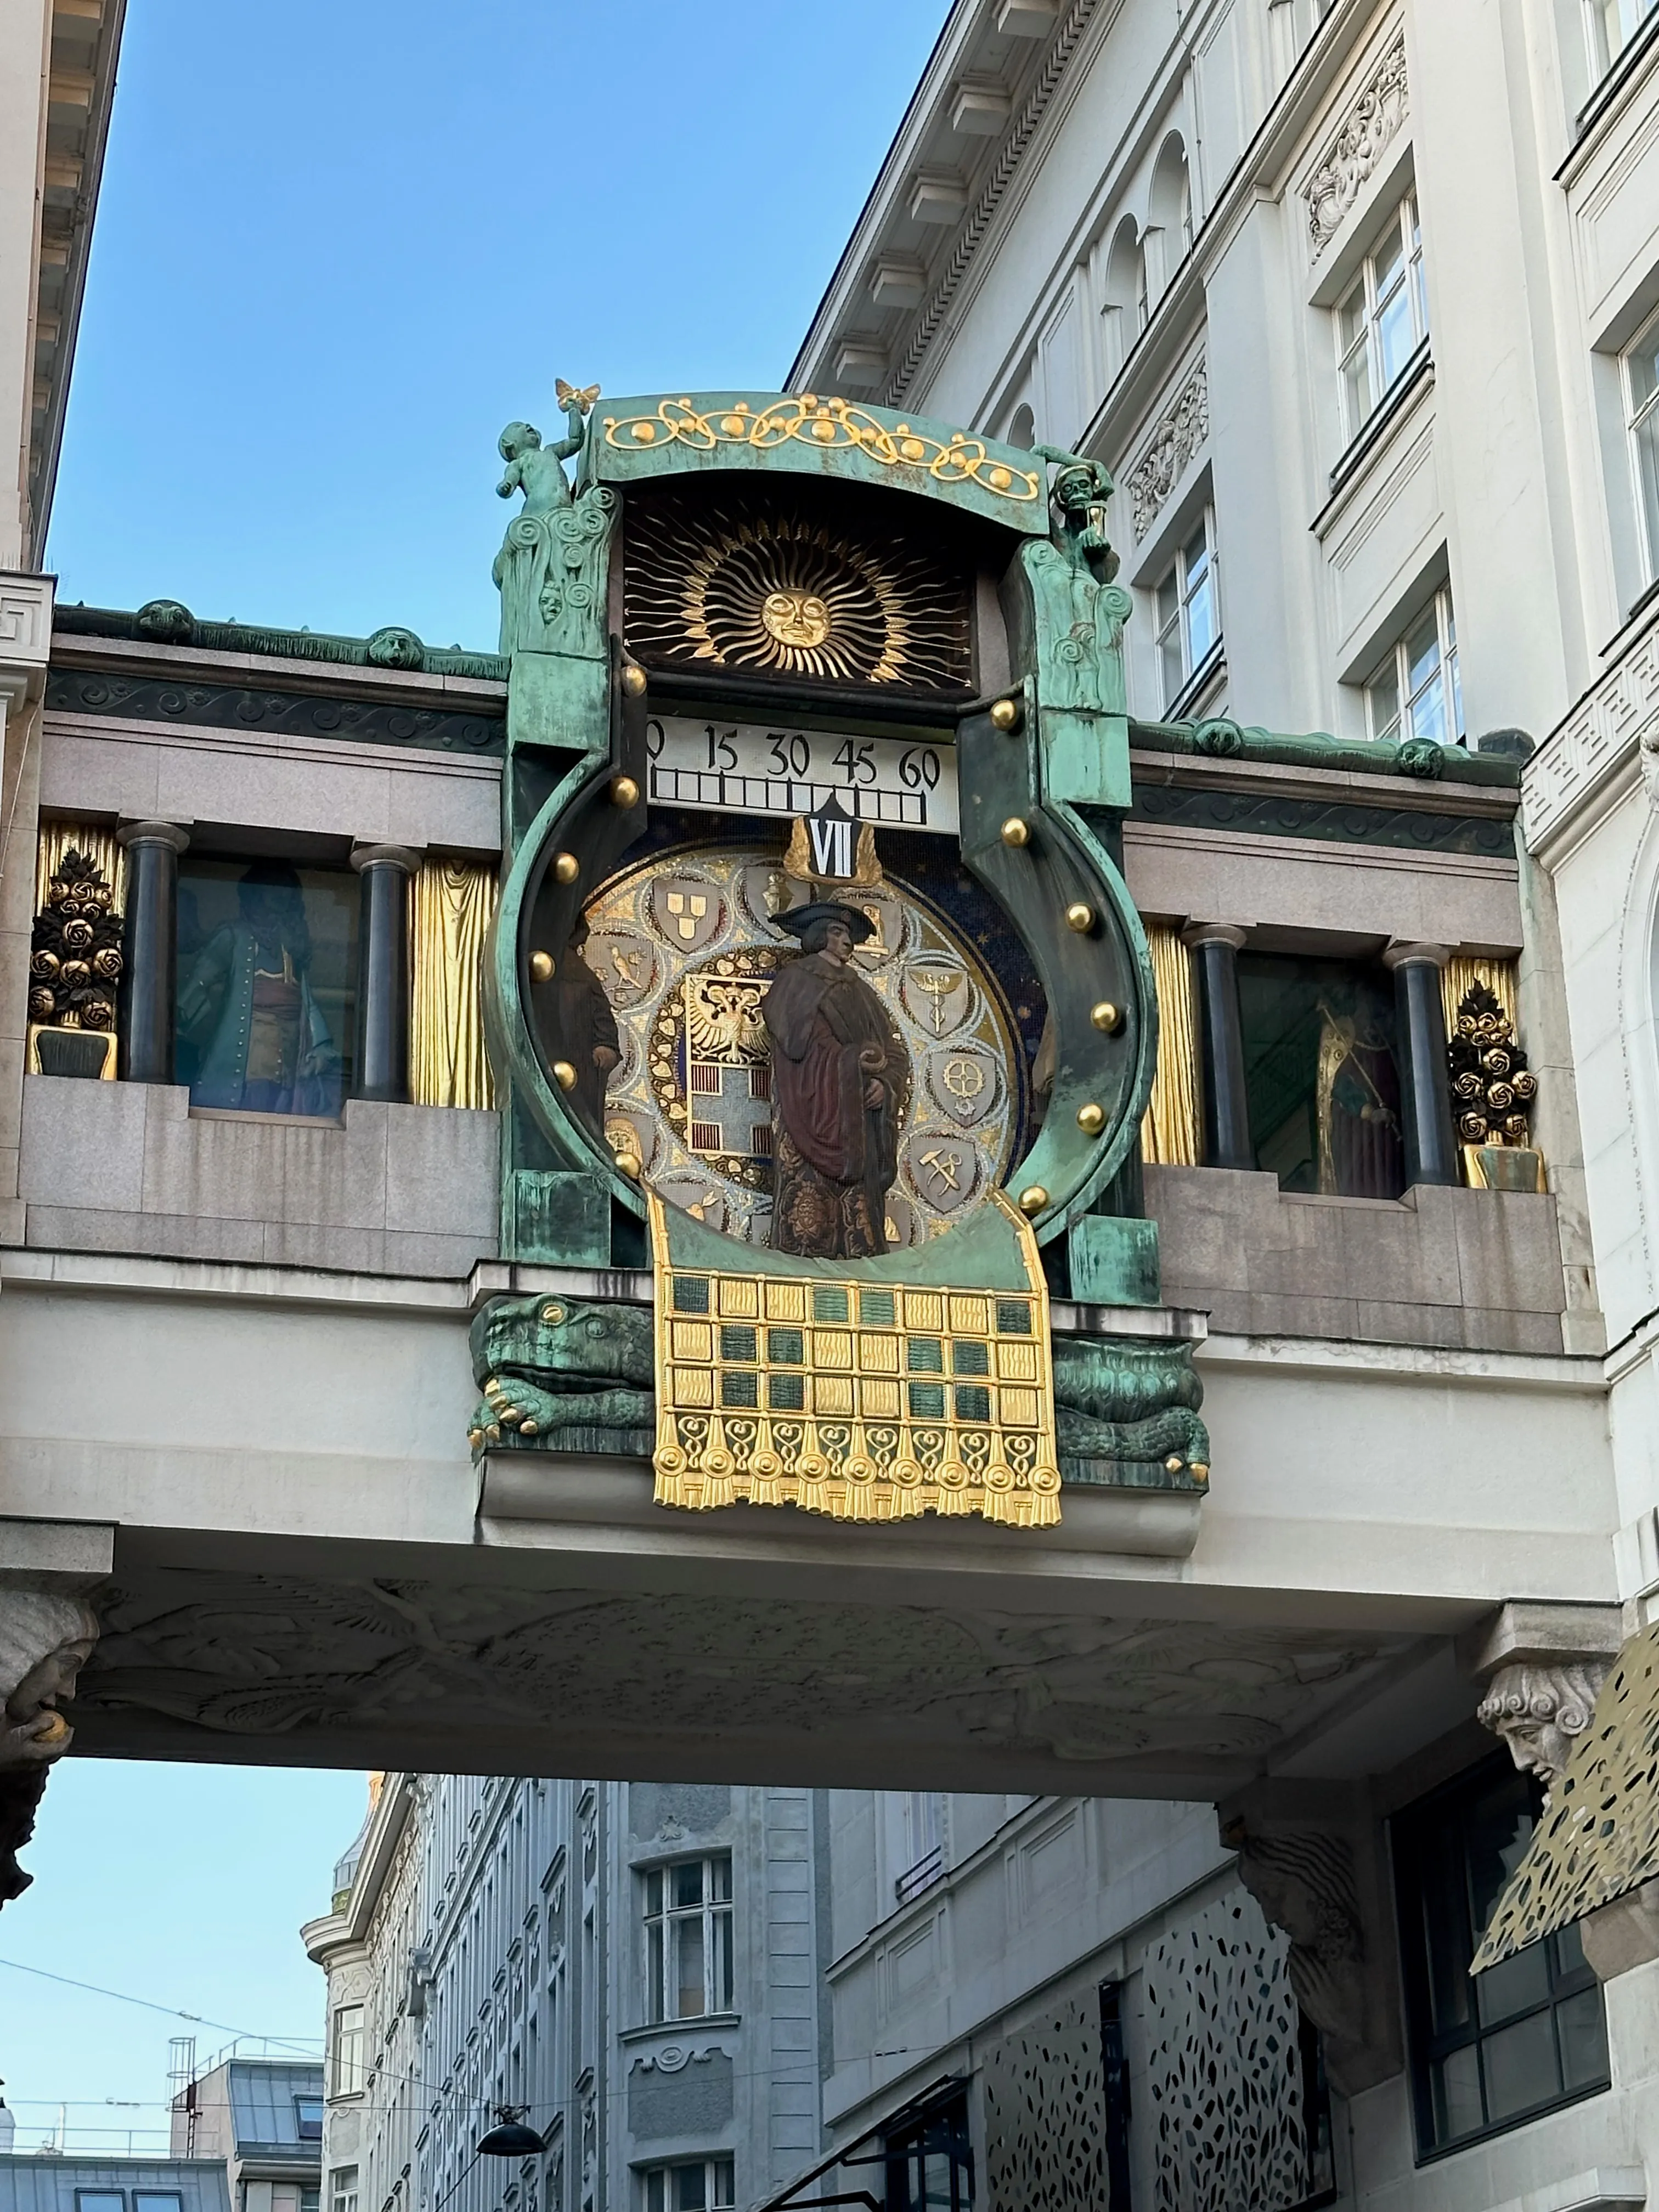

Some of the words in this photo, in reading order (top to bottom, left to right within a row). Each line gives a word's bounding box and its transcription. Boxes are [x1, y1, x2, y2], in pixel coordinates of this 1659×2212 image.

[647, 719, 665, 760] 0
[704, 725, 738, 770] 15
[766, 733, 810, 778] 30
[832, 739, 877, 783] 45
[899, 747, 940, 791] 60
[809, 819, 852, 877] VII
